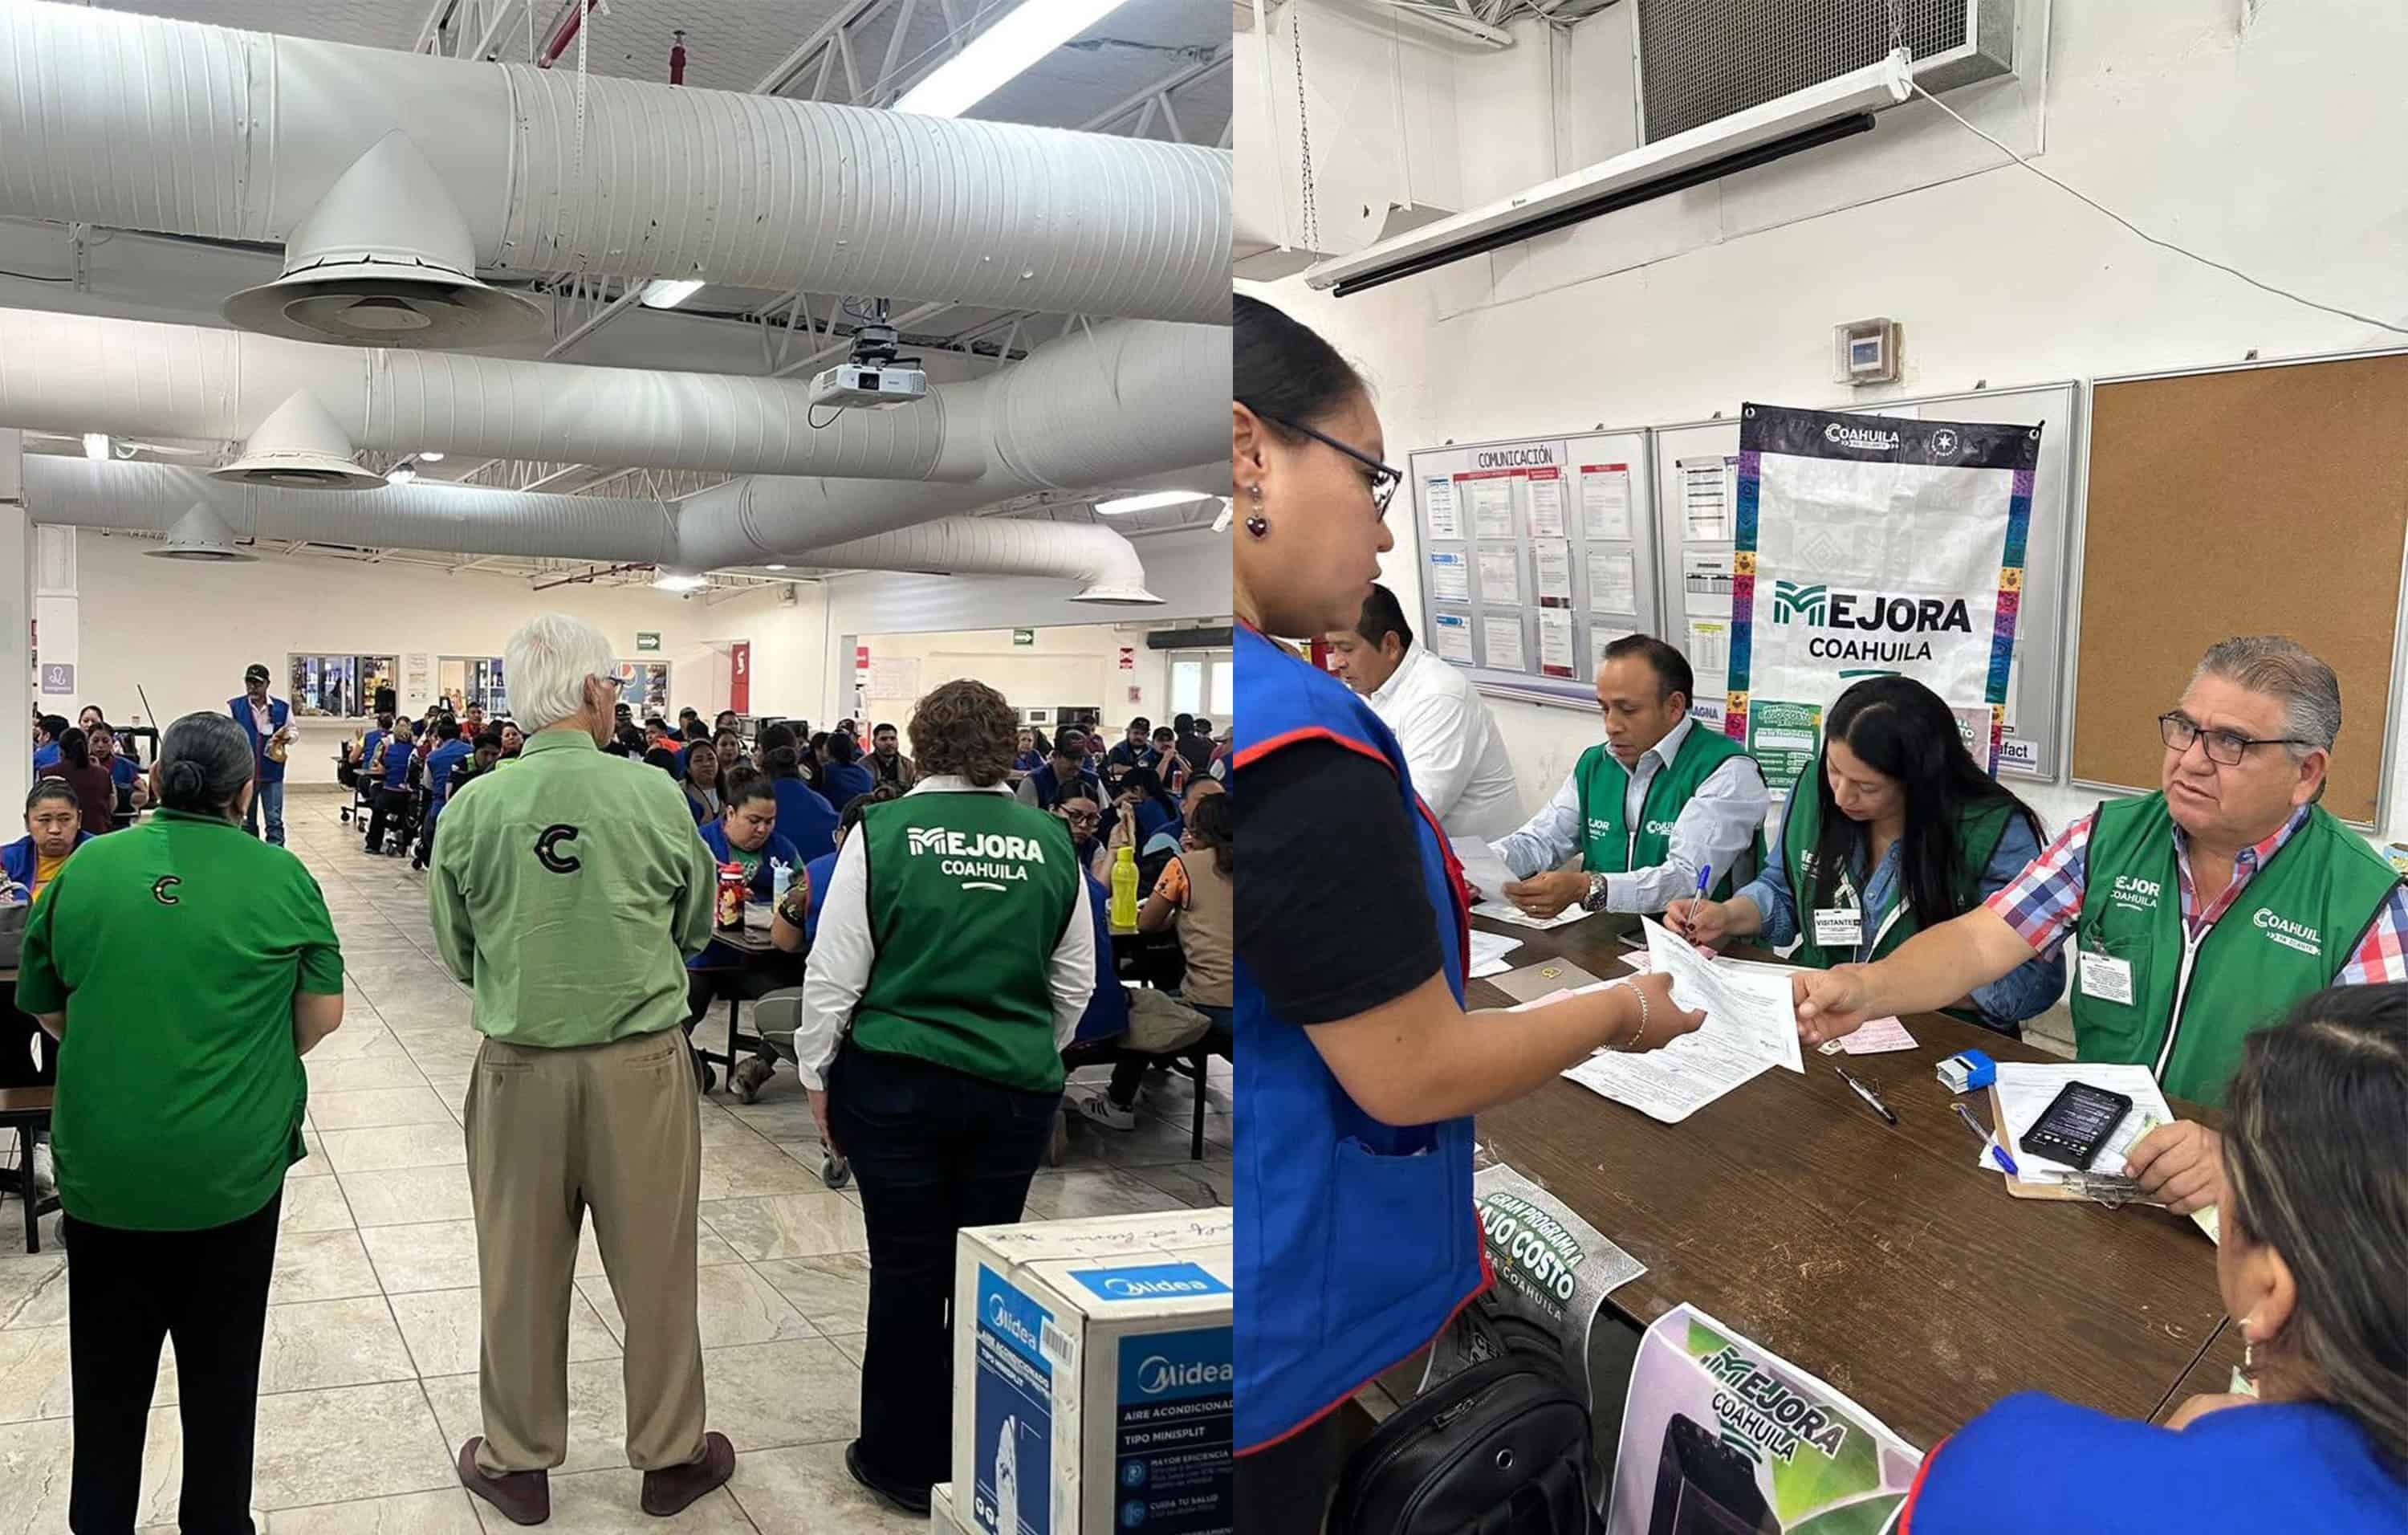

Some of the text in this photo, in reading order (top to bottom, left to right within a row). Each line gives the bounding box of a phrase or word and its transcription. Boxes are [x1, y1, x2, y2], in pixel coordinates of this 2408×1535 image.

[1824, 423, 1899, 442] COAHUILA
[1478, 445, 1553, 467] COMUNICACIÓN
[1773, 580, 1972, 633] MEJORA
[1808, 637, 1932, 662] COAHUILA
[1690, 706, 1719, 720] AGNA
[907, 827, 1045, 865] MEJORA
[942, 860, 1028, 881] COAHUILA
[2115, 875, 2160, 897] EJOR
[2253, 907, 2321, 943] COAHUIL
[1487, 1193, 1526, 1215] GRAN
[1511, 1230, 1575, 1300] COSTO
[1104, 1278, 1208, 1296] Midea
[1503, 1266, 1562, 1321] COAHUILA
[989, 1293, 1037, 1351] Midea
[1137, 1355, 1233, 1394] Midea
[1700, 1346, 1848, 1460] MEJORA
[1125, 1410, 1150, 1421] AIRE
[1125, 1427, 1205, 1445] TIPO MINISPLIT
[1712, 1391, 1799, 1466] COAHUILA
[1150, 1449, 1229, 1466] MAYOR EFICIENCIA
